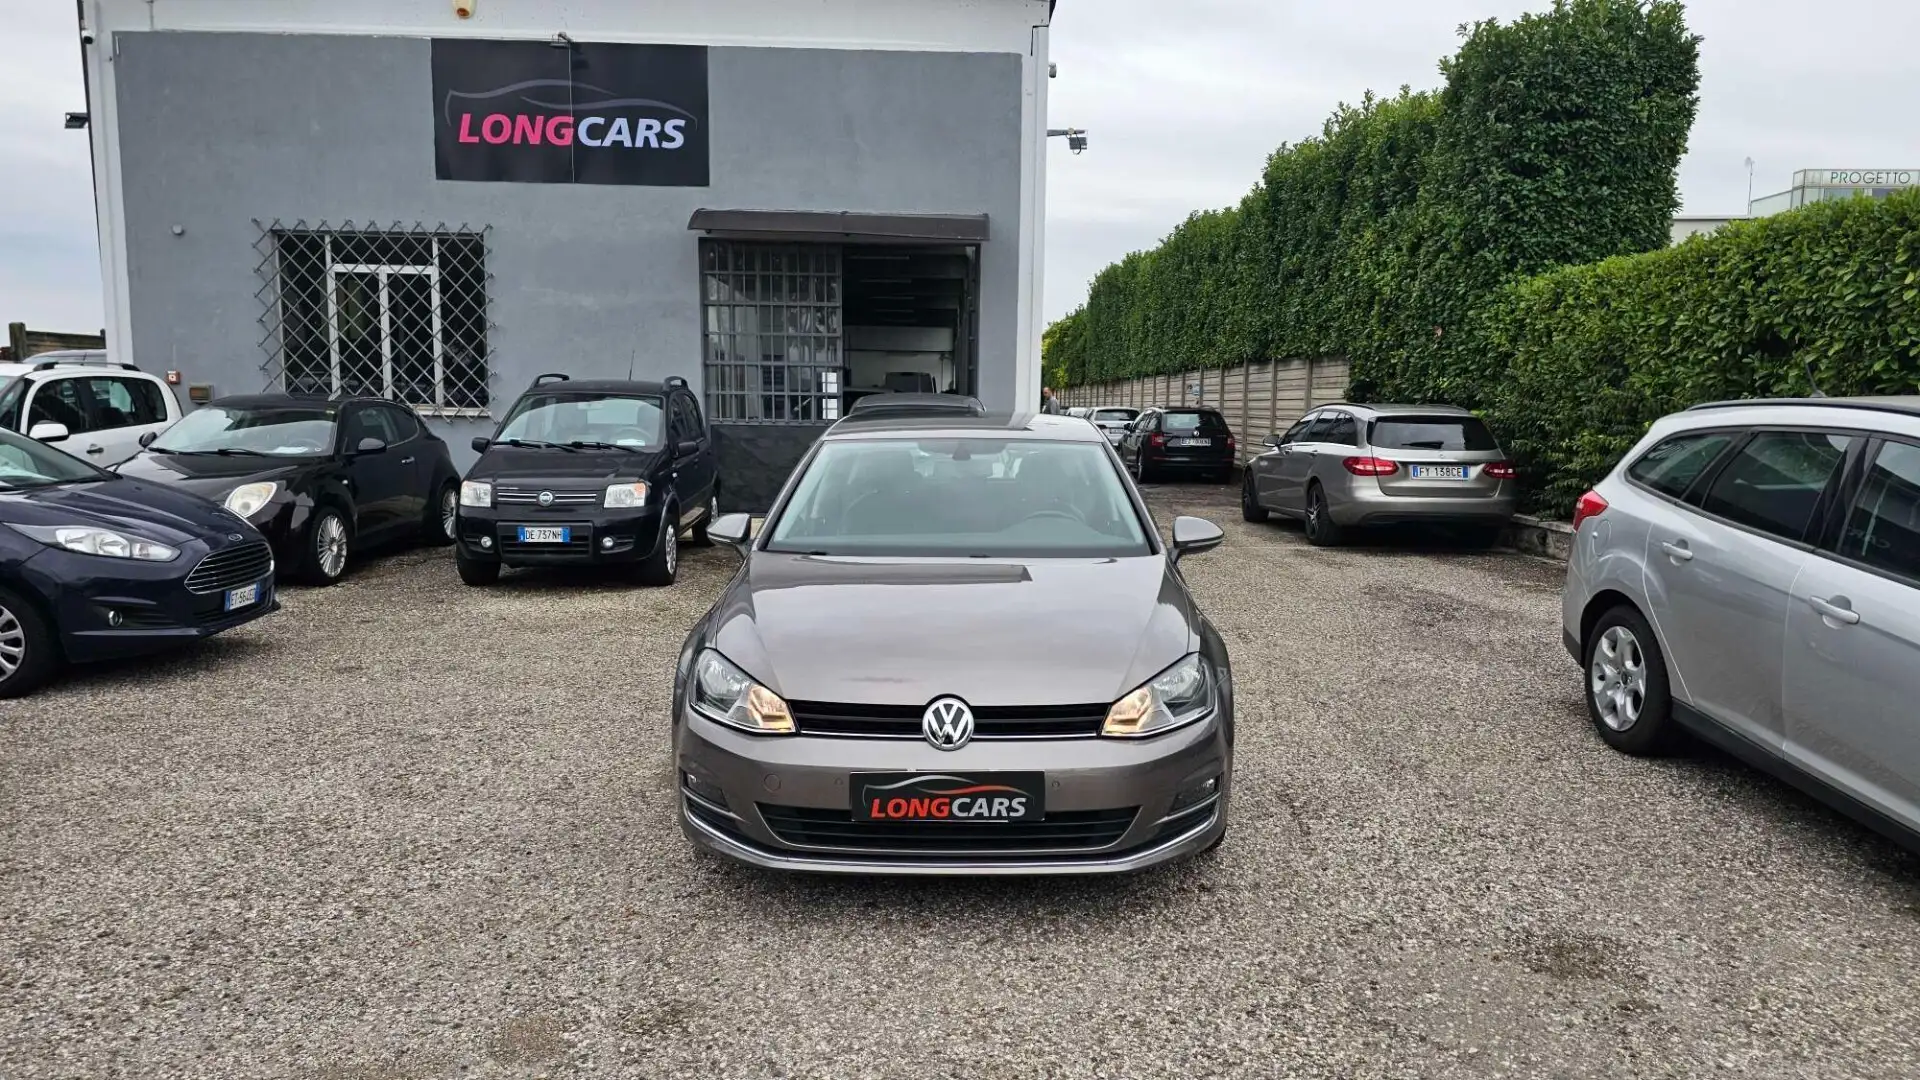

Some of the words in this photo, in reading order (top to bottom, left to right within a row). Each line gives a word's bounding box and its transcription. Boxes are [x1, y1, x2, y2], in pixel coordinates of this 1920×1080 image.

[458, 113, 687, 149] LONGCARS
[1830, 171, 1911, 184] PROGETTO
[1420, 467, 1430, 477] FY
[1434, 467, 1463, 477] 138CE
[525, 529, 535, 540] DE
[871, 797, 1027, 818] LONGCARS
